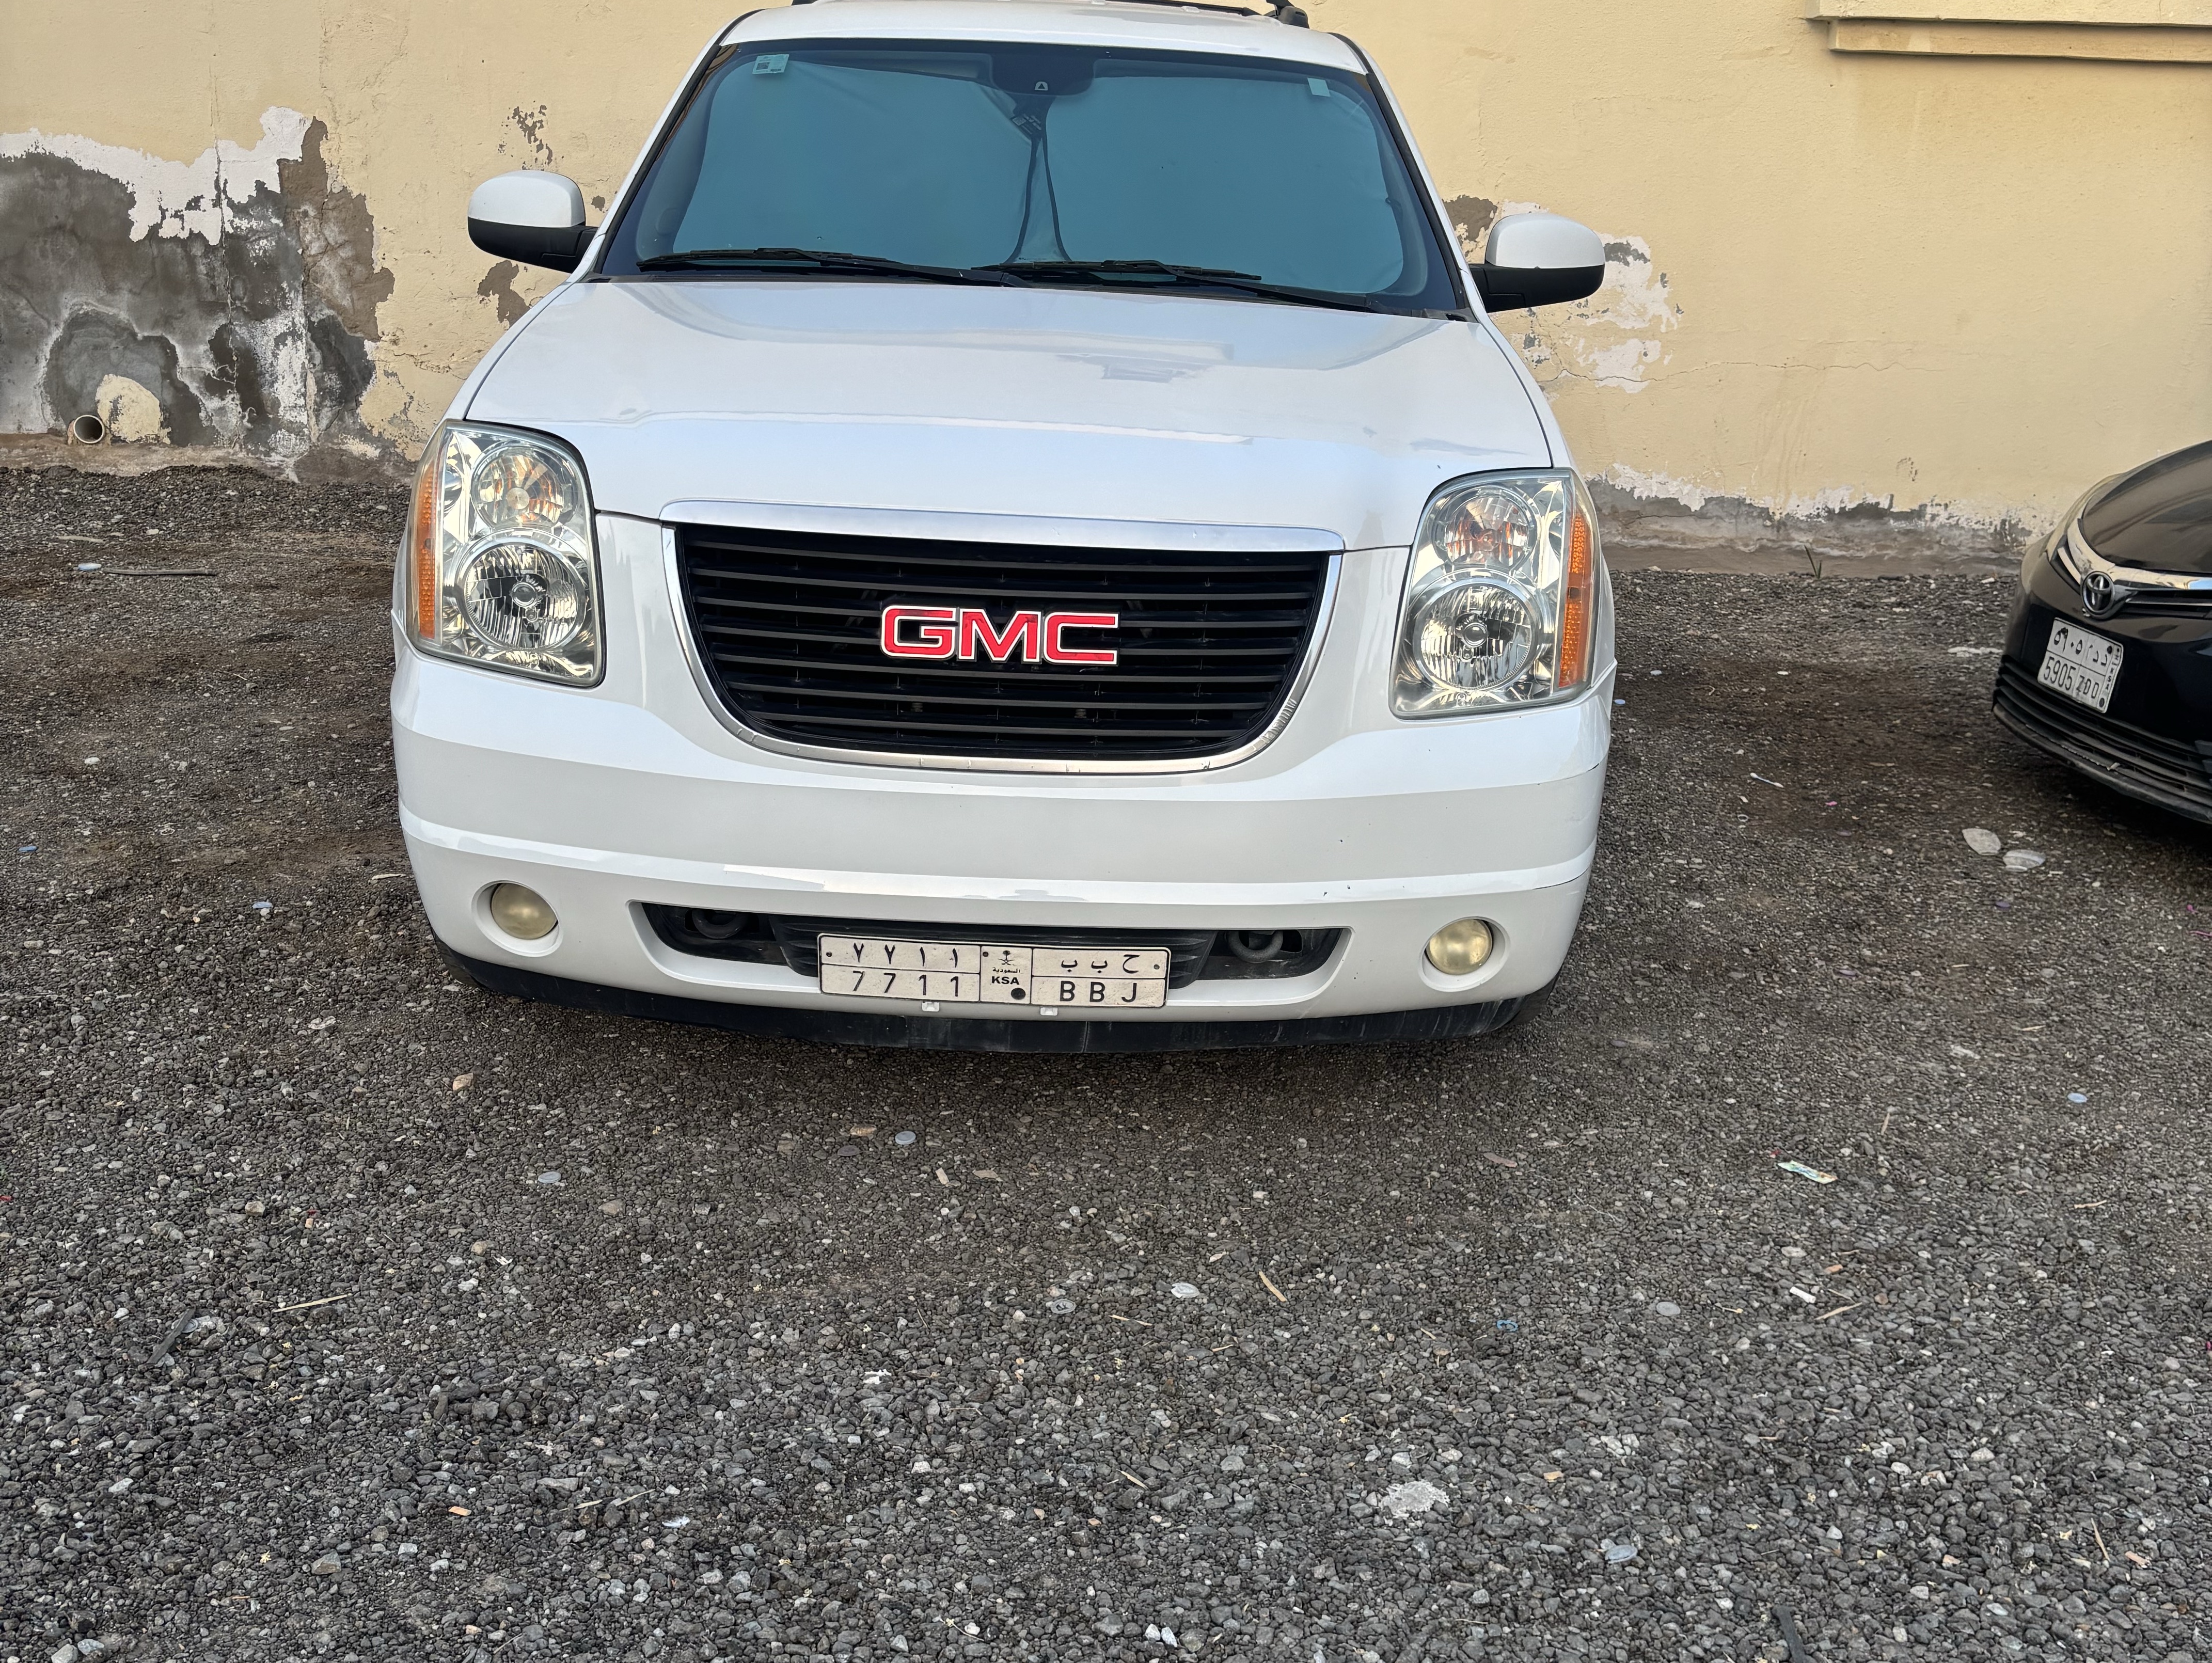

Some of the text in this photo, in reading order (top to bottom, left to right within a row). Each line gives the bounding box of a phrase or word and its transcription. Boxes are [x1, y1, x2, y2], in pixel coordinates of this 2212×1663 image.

[881, 605, 1119, 665] GMC
[2044, 656, 2076, 691] 5905
[852, 942, 959, 968] ٧٧١١
[852, 971, 959, 997] 7711
[991, 975, 1020, 985] KSA
